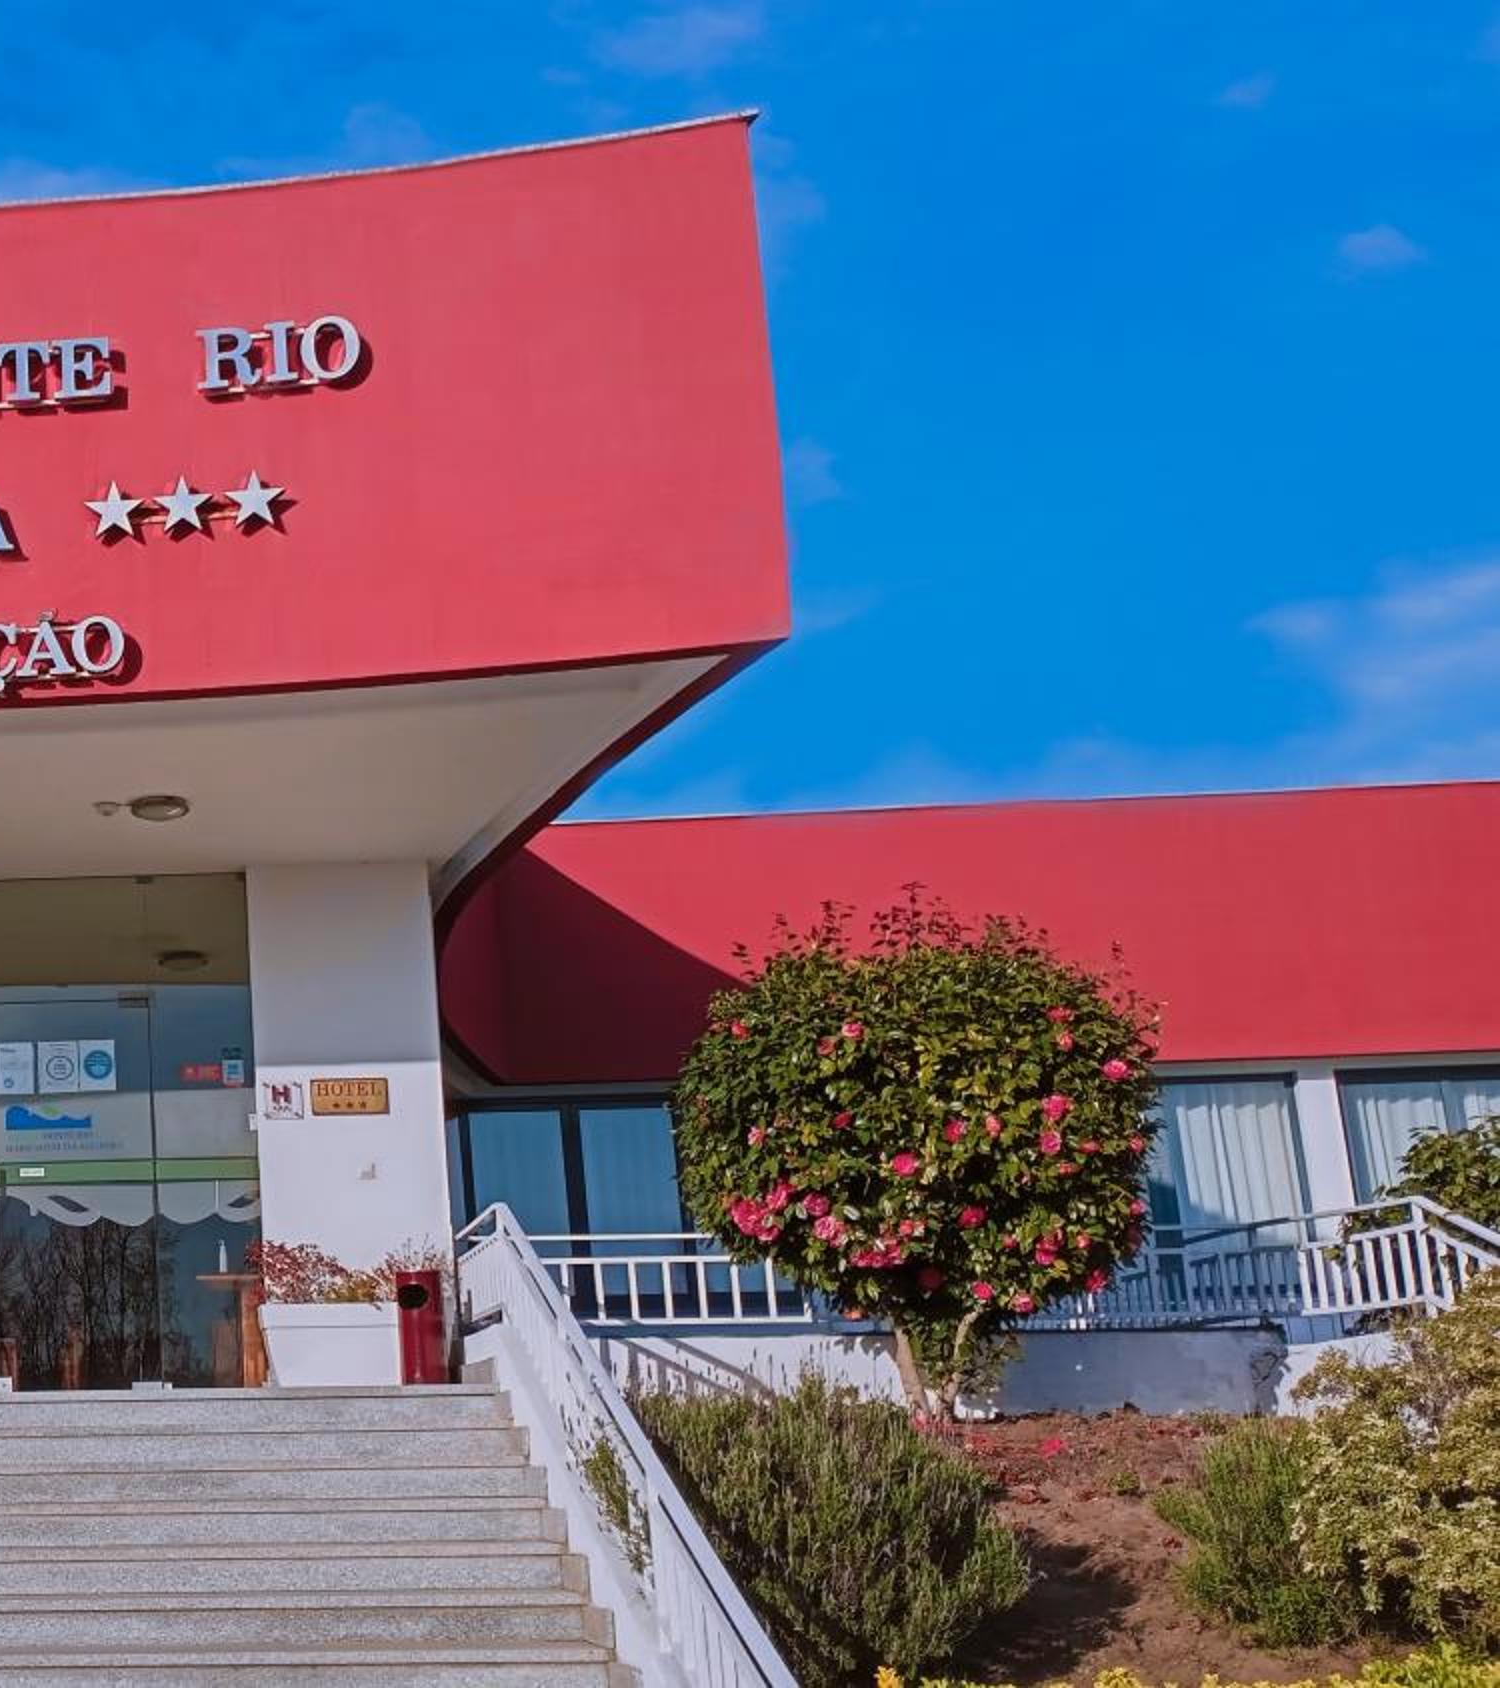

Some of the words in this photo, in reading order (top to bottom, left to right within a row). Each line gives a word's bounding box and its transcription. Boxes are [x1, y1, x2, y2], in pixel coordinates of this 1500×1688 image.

[197, 315, 361, 391] RIO
[271, 1084, 292, 1105] H
[316, 1081, 383, 1097] HOTEL
